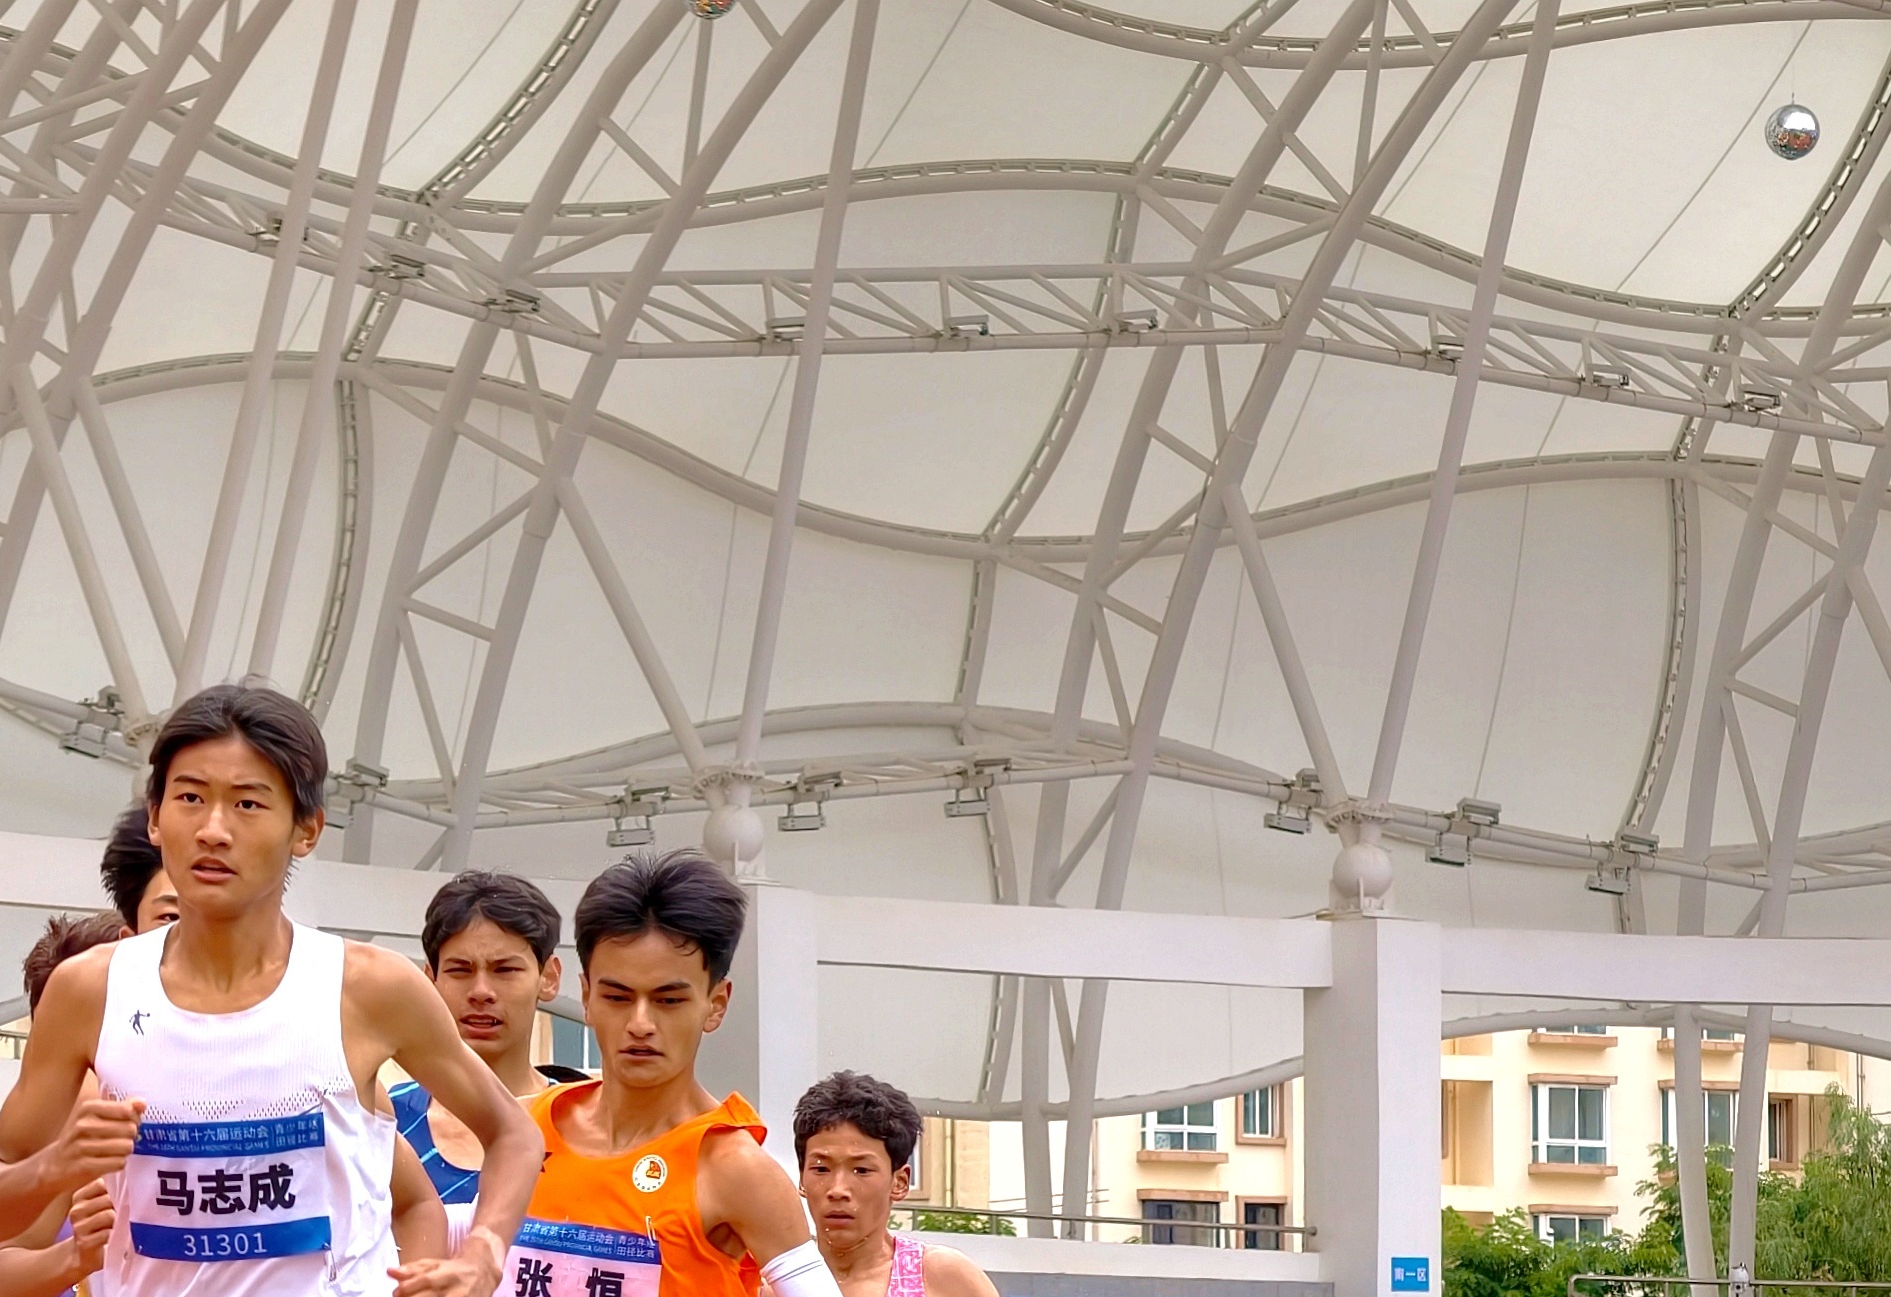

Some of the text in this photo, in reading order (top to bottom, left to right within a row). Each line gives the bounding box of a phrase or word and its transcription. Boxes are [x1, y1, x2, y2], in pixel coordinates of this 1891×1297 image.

[156, 1163, 296, 1215] 马志成
[183, 1233, 268, 1257] 31301
